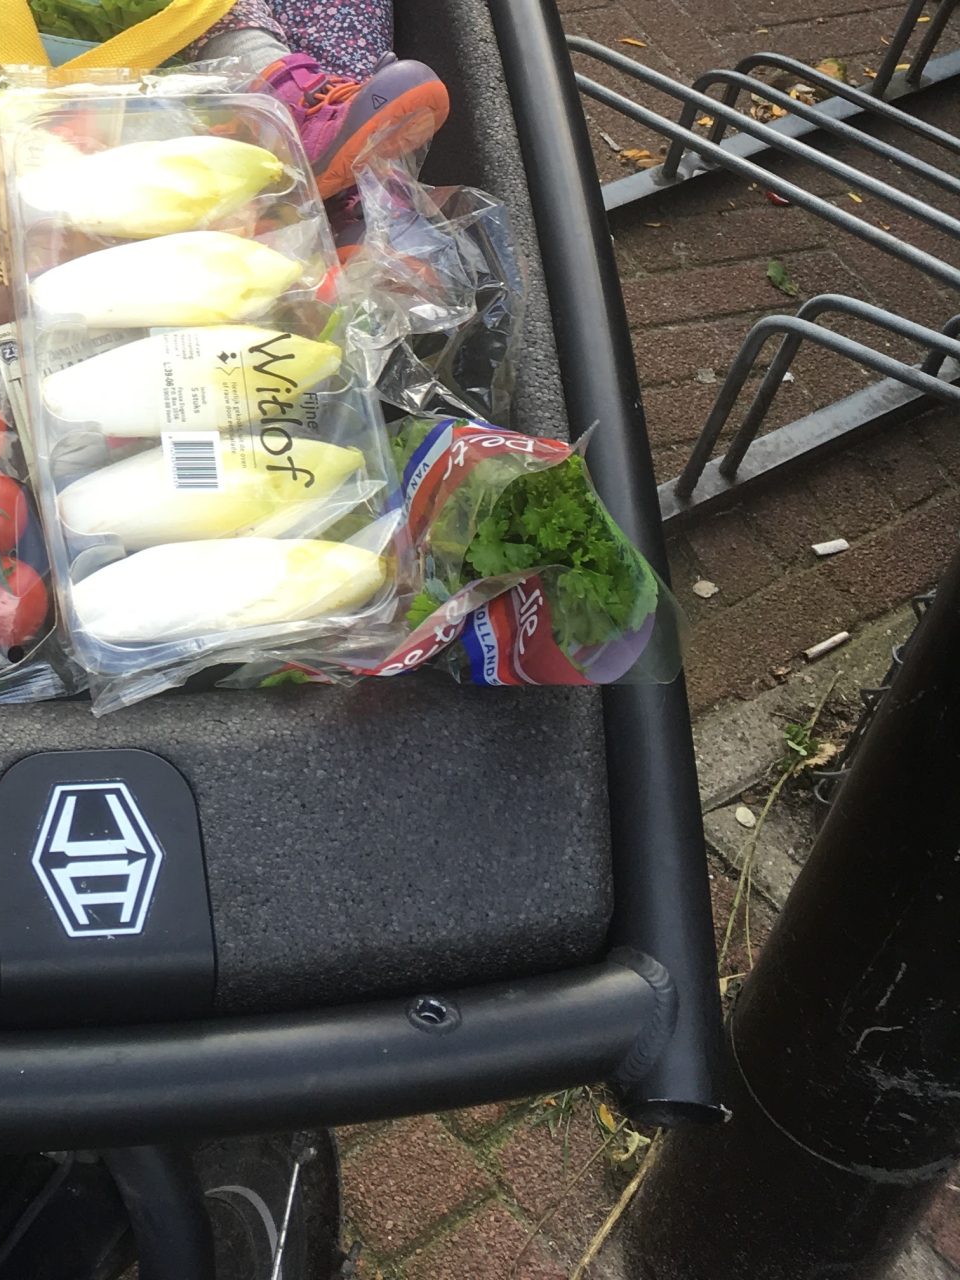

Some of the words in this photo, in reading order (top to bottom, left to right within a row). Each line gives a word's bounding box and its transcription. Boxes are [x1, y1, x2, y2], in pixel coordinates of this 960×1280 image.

[192, 393, 201, 414] stuks
[248, 333, 315, 488] Witlof
[303, 392, 319, 430] Fijne
[410, 462, 430, 490] VAN
